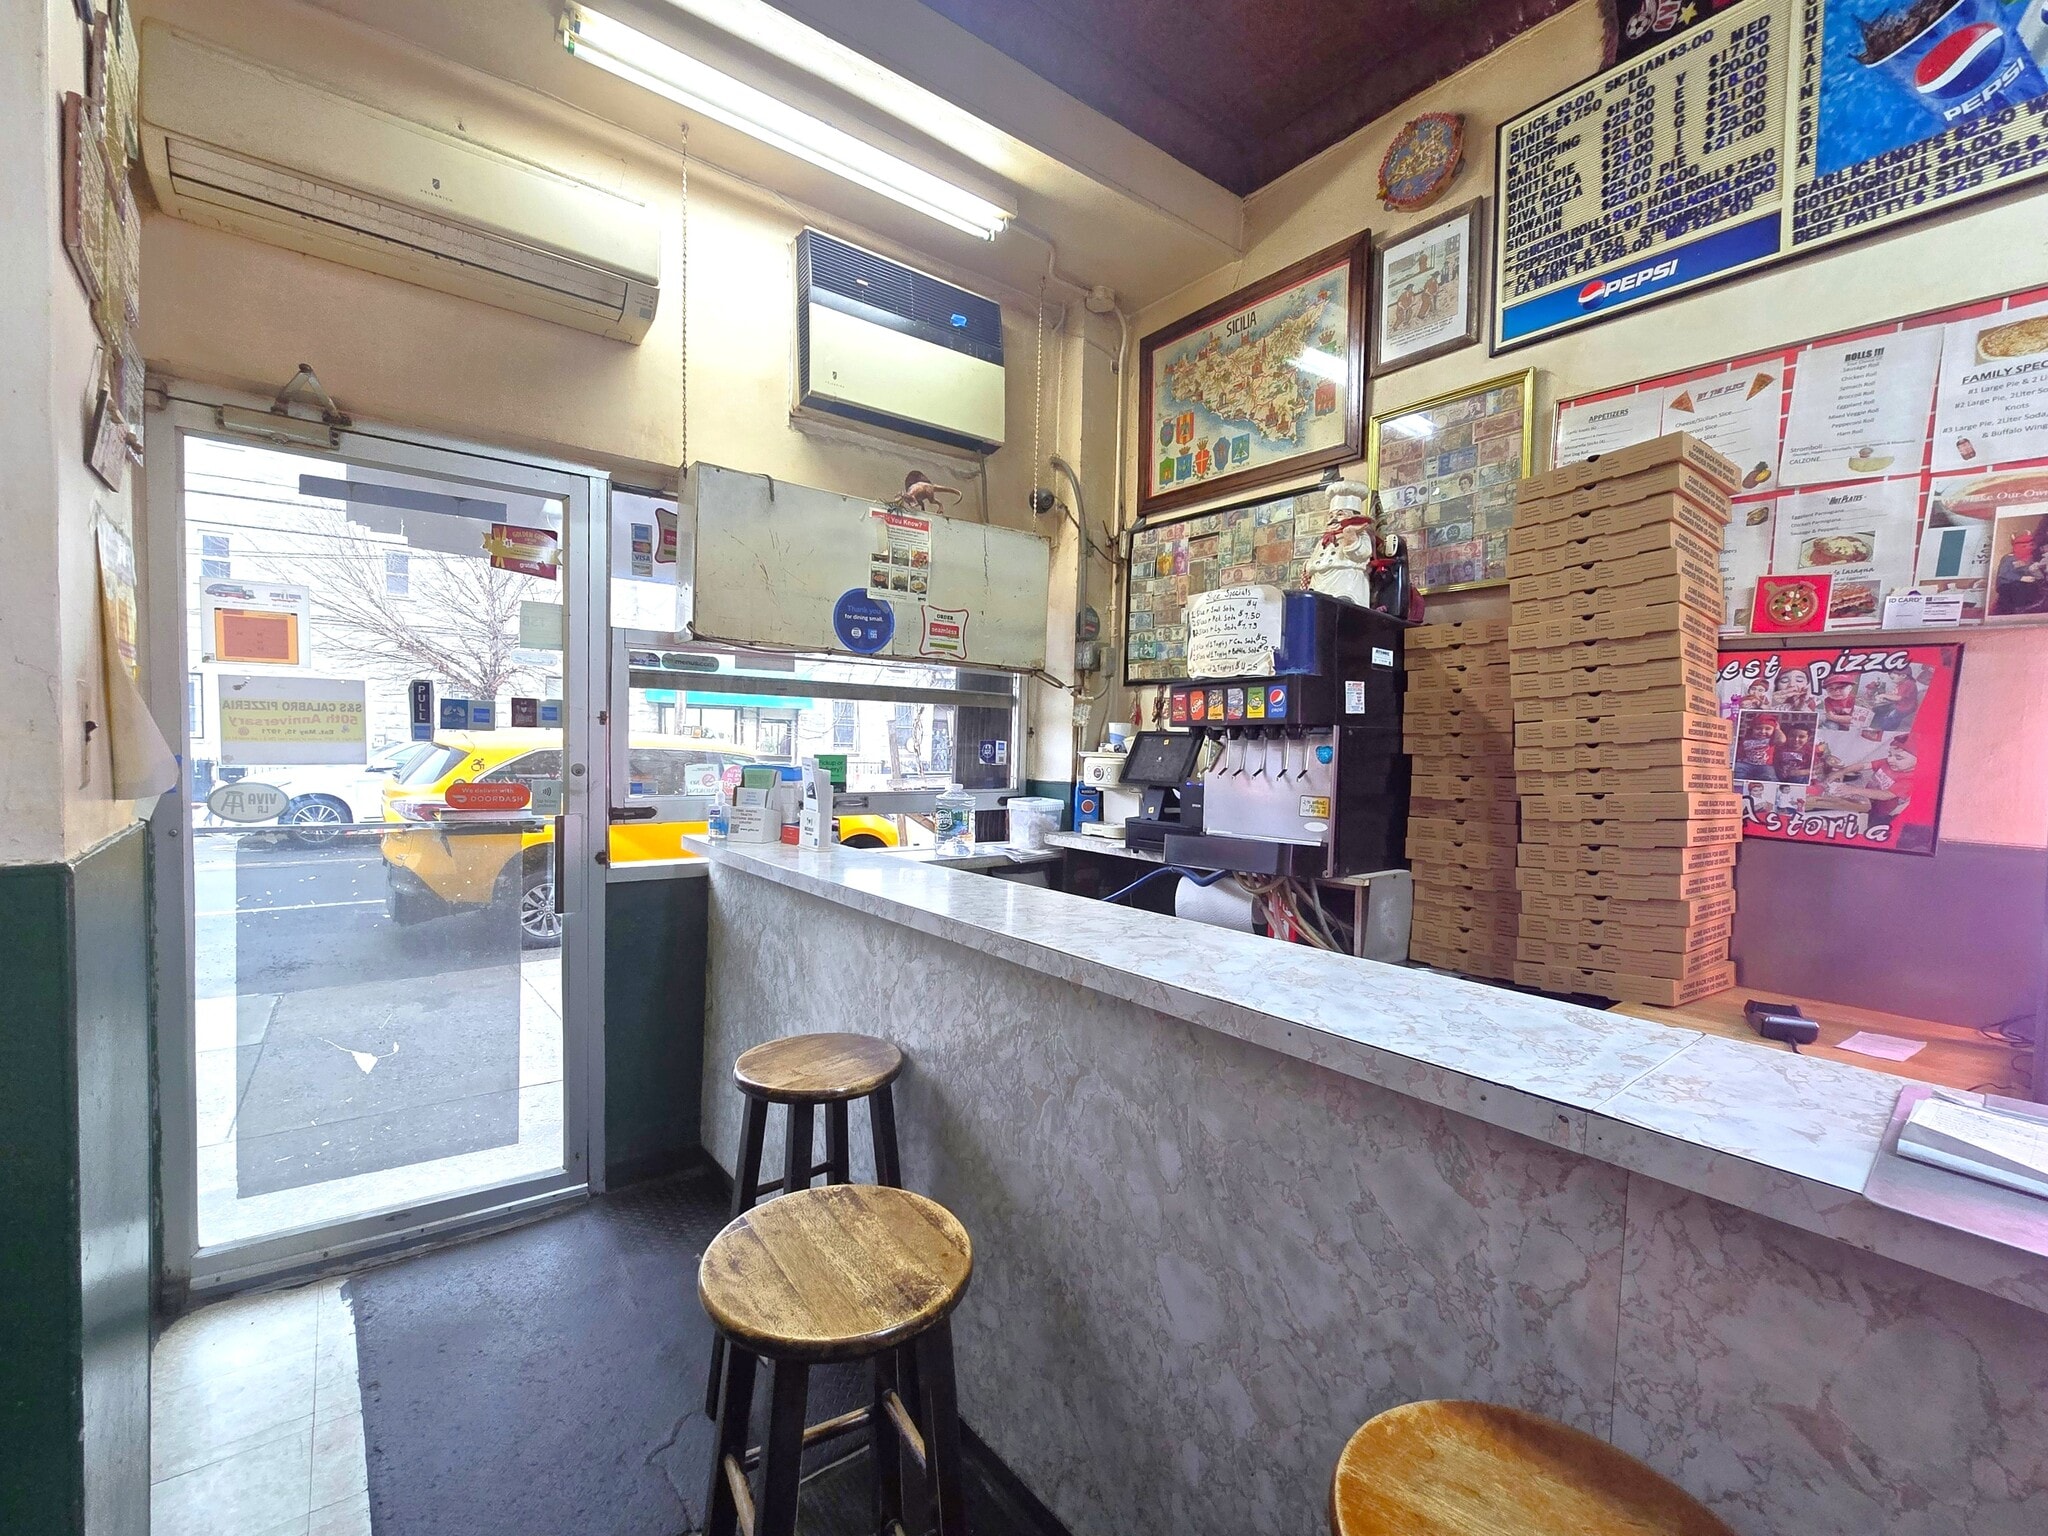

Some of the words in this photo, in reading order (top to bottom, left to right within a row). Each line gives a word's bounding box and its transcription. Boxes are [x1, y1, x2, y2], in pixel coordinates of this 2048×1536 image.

[1628, 76, 1647, 94] LG
[1731, 15, 1770, 44] MED
[1510, 133, 1558, 165] CHEESE
[1607, 85, 1655, 117] $19.50
[1709, 30, 1769, 67] $17.00
[1511, 113, 1549, 141] SLICE
[1557, 91, 1595, 117] $3.00
[1605, 53, 1665, 93] SICILIAN
[1668, 29, 1714, 60] $3.00
[1944, 57, 2026, 122] PEPSI
[1524, 134, 1581, 169] TOPPING
[1602, 99, 1654, 132] $23.00
[1708, 45, 1769, 81] $20.00
[1673, 71, 1687, 156] VEGGIE
[1508, 160, 1555, 190] GARLIC
[1602, 113, 1654, 145] $21.00
[1708, 60, 1767, 96] $18.00
[1508, 173, 1549, 202] WHITE
[1553, 162, 1575, 181] PIE
[1602, 127, 1653, 159] $23.00
[1707, 75, 1767, 111] $21.00
[1510, 131, 1540, 154] MINI
[1543, 120, 1563, 137] PIE
[1796, 105, 1813, 170] SODA
[1938, 130, 2002, 163] $4.00
[1508, 173, 1582, 214] RAFFAELLA
[1602, 140, 1654, 172] $26.00
[1508, 207, 1562, 240] HAWAIIN
[1601, 167, 1650, 197] $25.00
[1703, 119, 1765, 155] $21.00
[1509, 206, 1536, 227] DIVA
[1543, 186, 1582, 209] PIZZA
[1602, 154, 1653, 185] $27.00
[1706, 104, 1766, 139] $23.00
[1659, 154, 1687, 177] PIE
[1795, 163, 1870, 199] GARLIC
[1875, 132, 1948, 169] KNOTS
[1793, 171, 1929, 230] MOZZARELLA
[1936, 141, 2020, 180] STICKS
[1506, 219, 1562, 251] SICILIAN
[1602, 182, 1650, 211] $23.00
[1517, 232, 1568, 261] CHICKEN
[1571, 218, 1602, 241] ROLL
[1648, 188, 1682, 209] HAM
[1686, 169, 1722, 193] ROLL
[1792, 218, 1839, 246] BEEF
[1844, 195, 1909, 229] PATTY
[1515, 239, 1583, 275] PEPPERONI
[1590, 225, 1622, 245] ROLL
[1575, 257, 1597, 275] PIE
[1517, 254, 1577, 285] CALZONE
[1604, 259, 1679, 298] PEPSI
[1226, 311, 1257, 337] SICILIA
[1844, 349, 1872, 363] ROLLS
[1961, 367, 2013, 385] FAMILY
[1981, 384, 2004, 393] Large
[1588, 408, 1629, 423] APPETIZERS
[1967, 398, 1990, 407] Large
[2004, 402, 2030, 412] Knots
[1955, 423, 1978, 432] Large
[1991, 427, 2023, 437] Buffalo
[1789, 456, 1820, 465] CALZONE
[847, 605, 867, 614] Thank
[853, 614, 869, 622] dining
[936, 613, 953, 621] ORDER
[931, 627, 957, 635] seamless
[1716, 654, 1781, 684] est
[417, 685, 426, 721] PULL
[470, 795, 524, 803] DOORDASH
